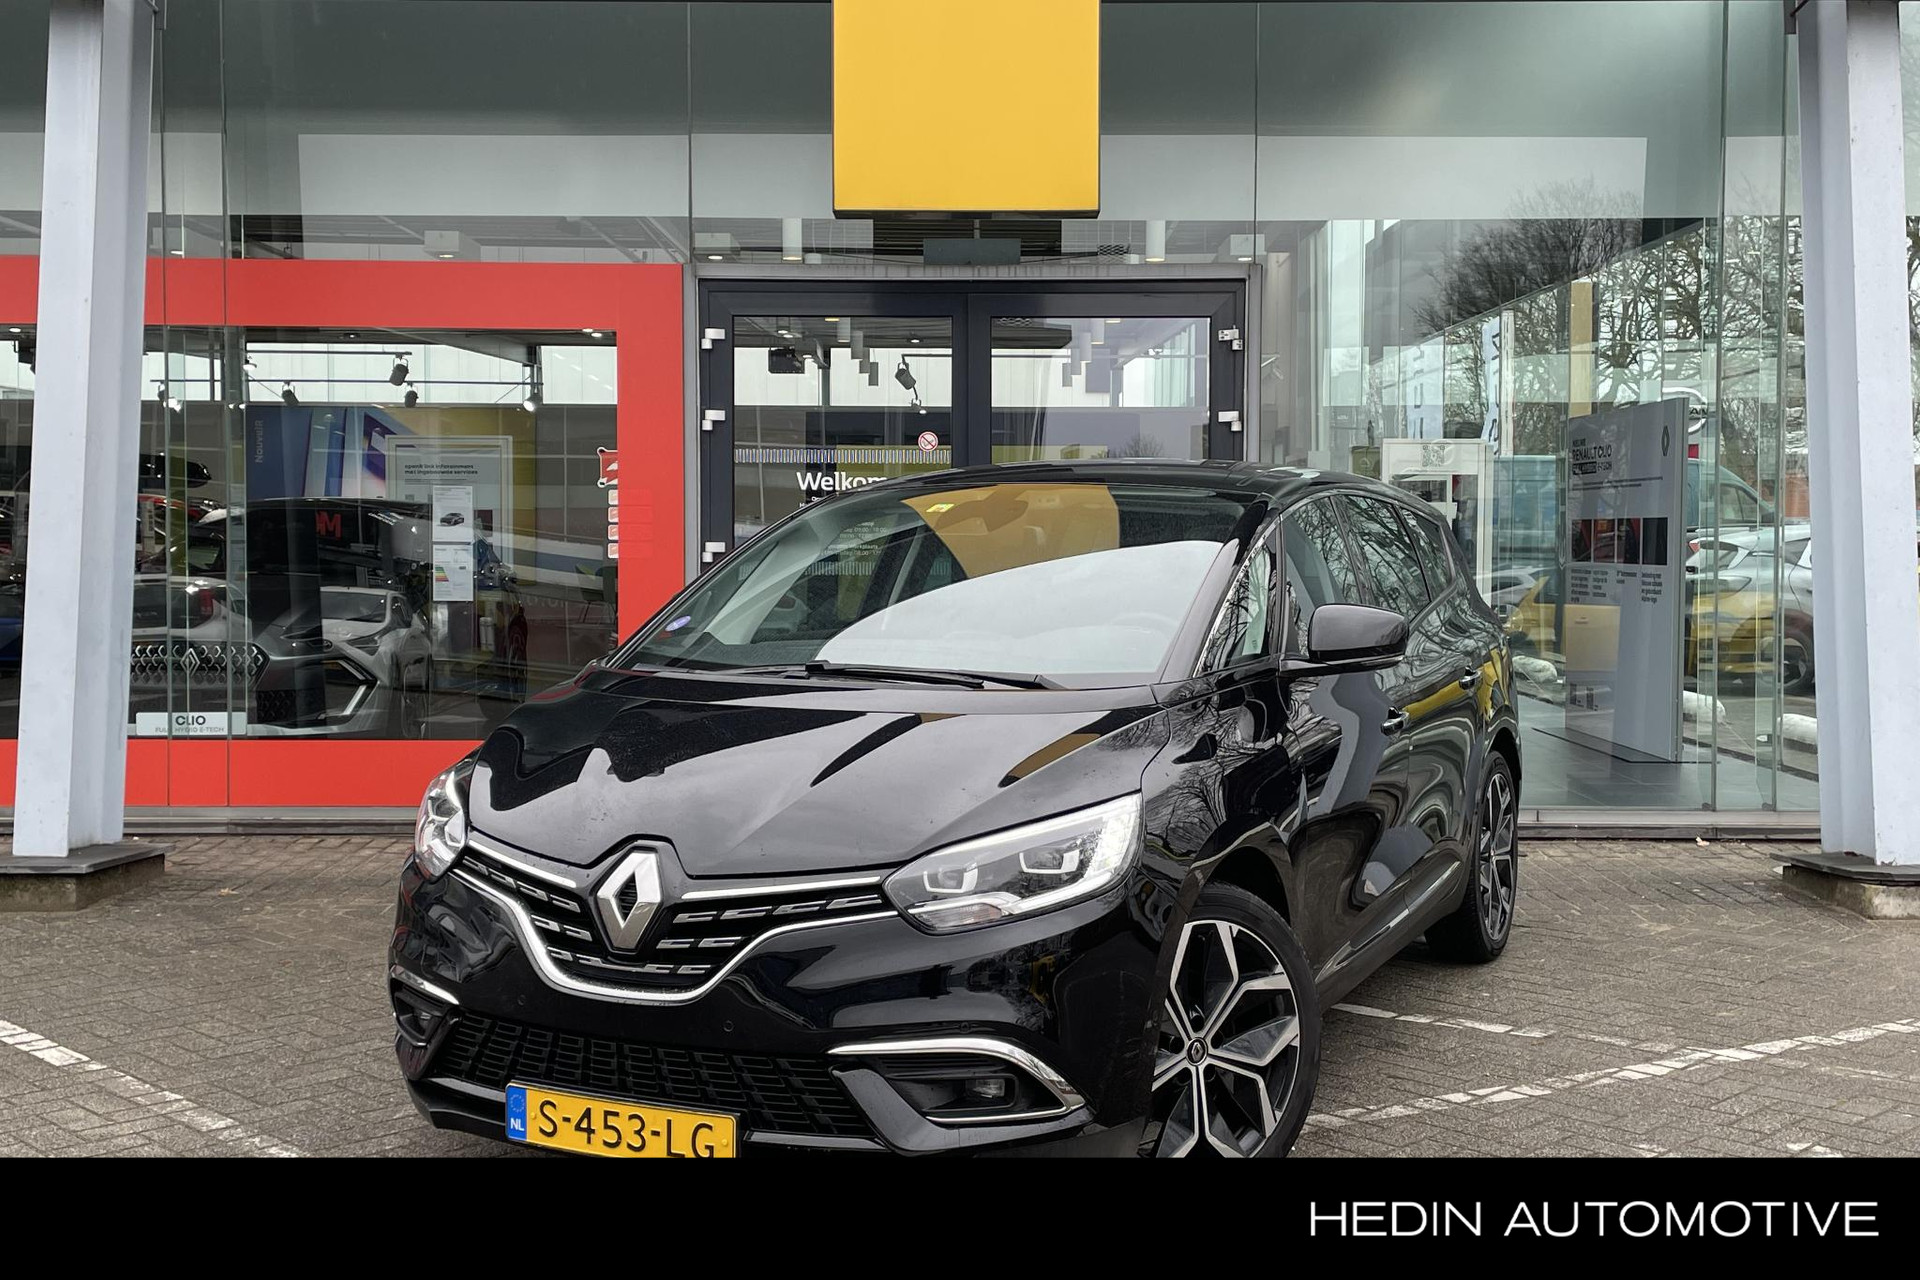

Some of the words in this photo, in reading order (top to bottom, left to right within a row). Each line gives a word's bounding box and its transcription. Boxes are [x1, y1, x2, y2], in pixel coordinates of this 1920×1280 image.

[796, 472, 888, 490] Welko
[175, 716, 206, 726] CLIO
[510, 1117, 524, 1131] NL
[538, 1099, 715, 1158] S-453-LG
